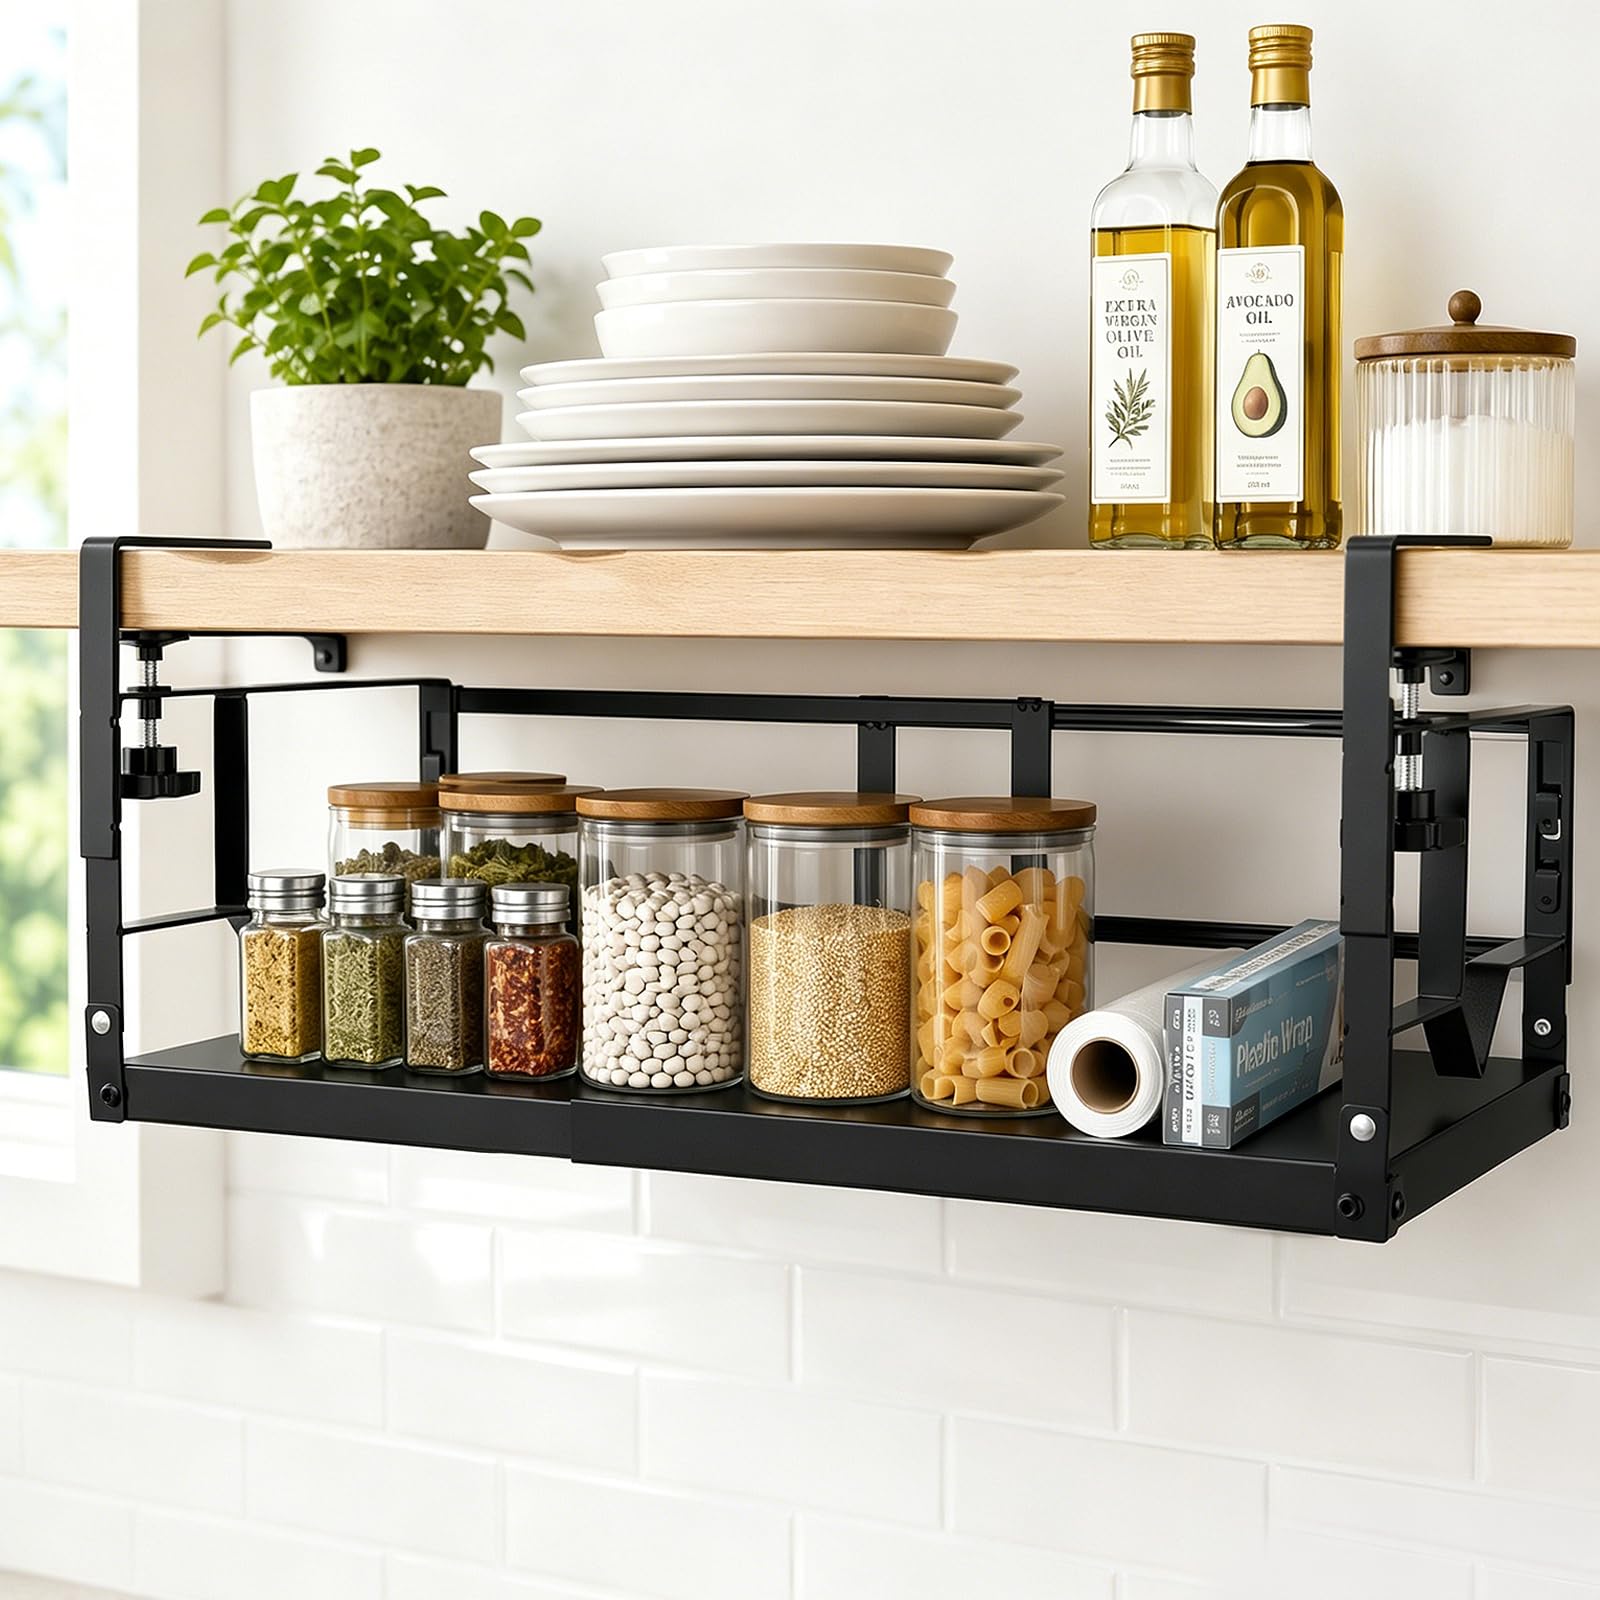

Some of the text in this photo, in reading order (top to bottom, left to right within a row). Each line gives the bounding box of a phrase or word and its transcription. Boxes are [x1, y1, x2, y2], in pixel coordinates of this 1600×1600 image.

[1226, 293, 1294, 309] AVOCADO
[1246, 311, 1273, 325] OIL
[1106, 330, 1154, 344] OLIVE
[1117, 345, 1143, 359] OIL
[1281, 1015, 1313, 1054] Wrap
